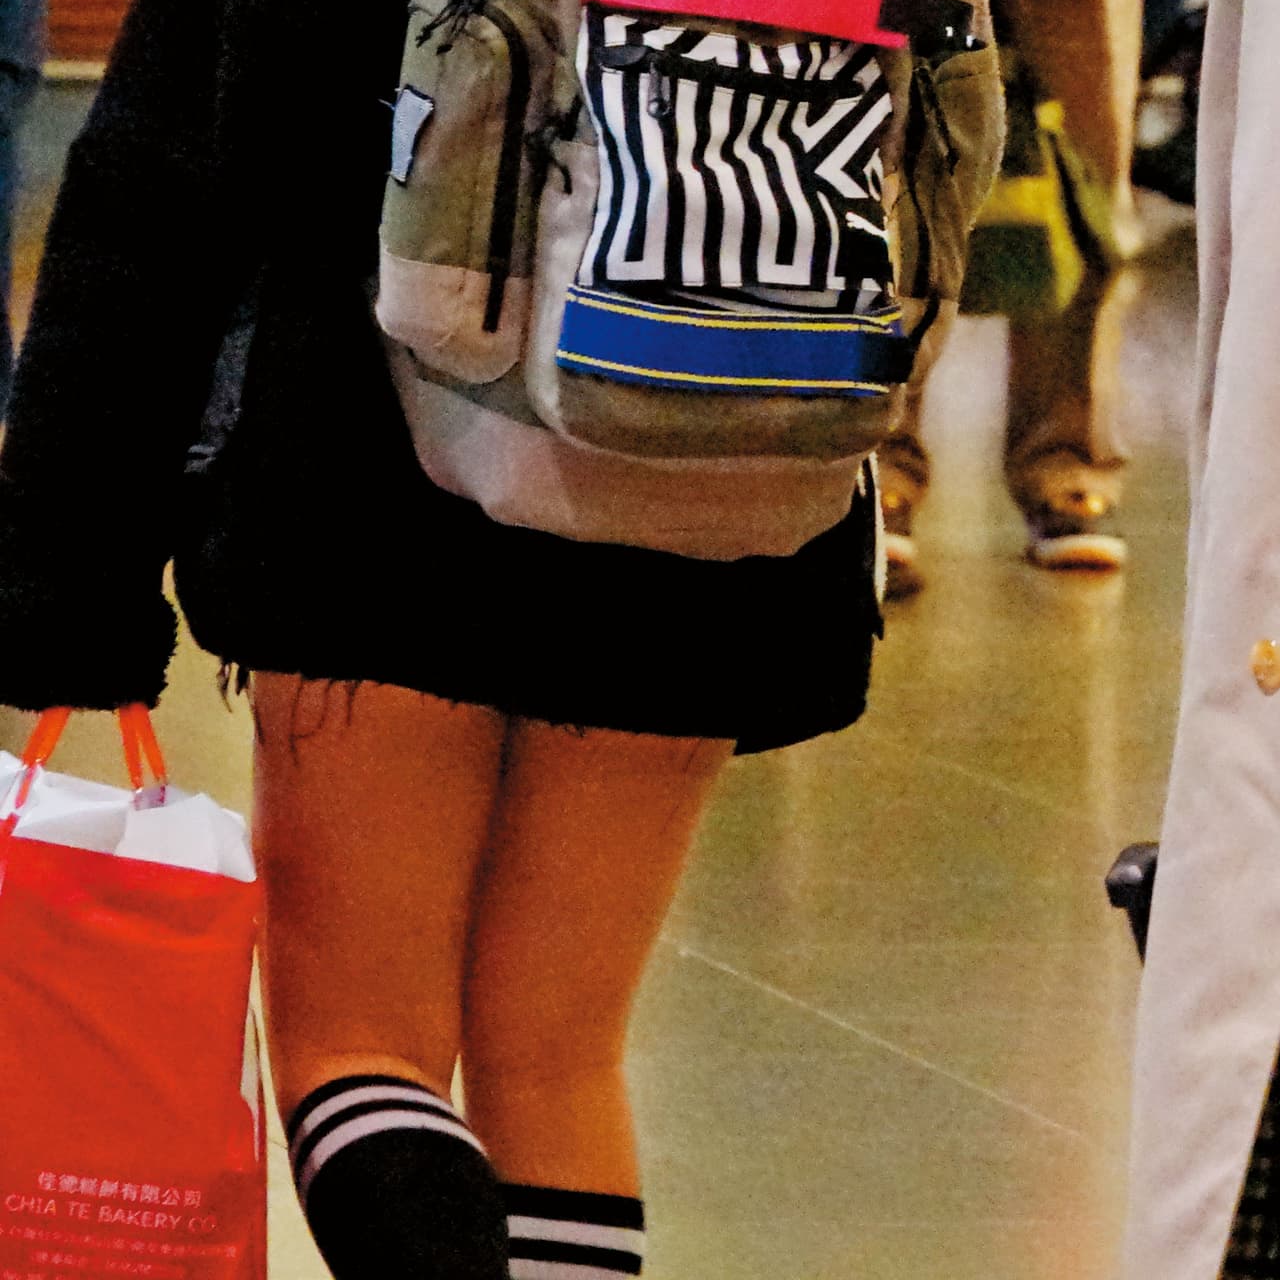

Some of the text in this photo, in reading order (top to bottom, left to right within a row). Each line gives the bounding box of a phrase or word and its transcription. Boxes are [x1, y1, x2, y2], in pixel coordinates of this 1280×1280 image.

[5, 1194, 57, 1216] CHIA
[67, 1200, 91, 1220] TE
[98, 1205, 181, 1230] BAKERY
